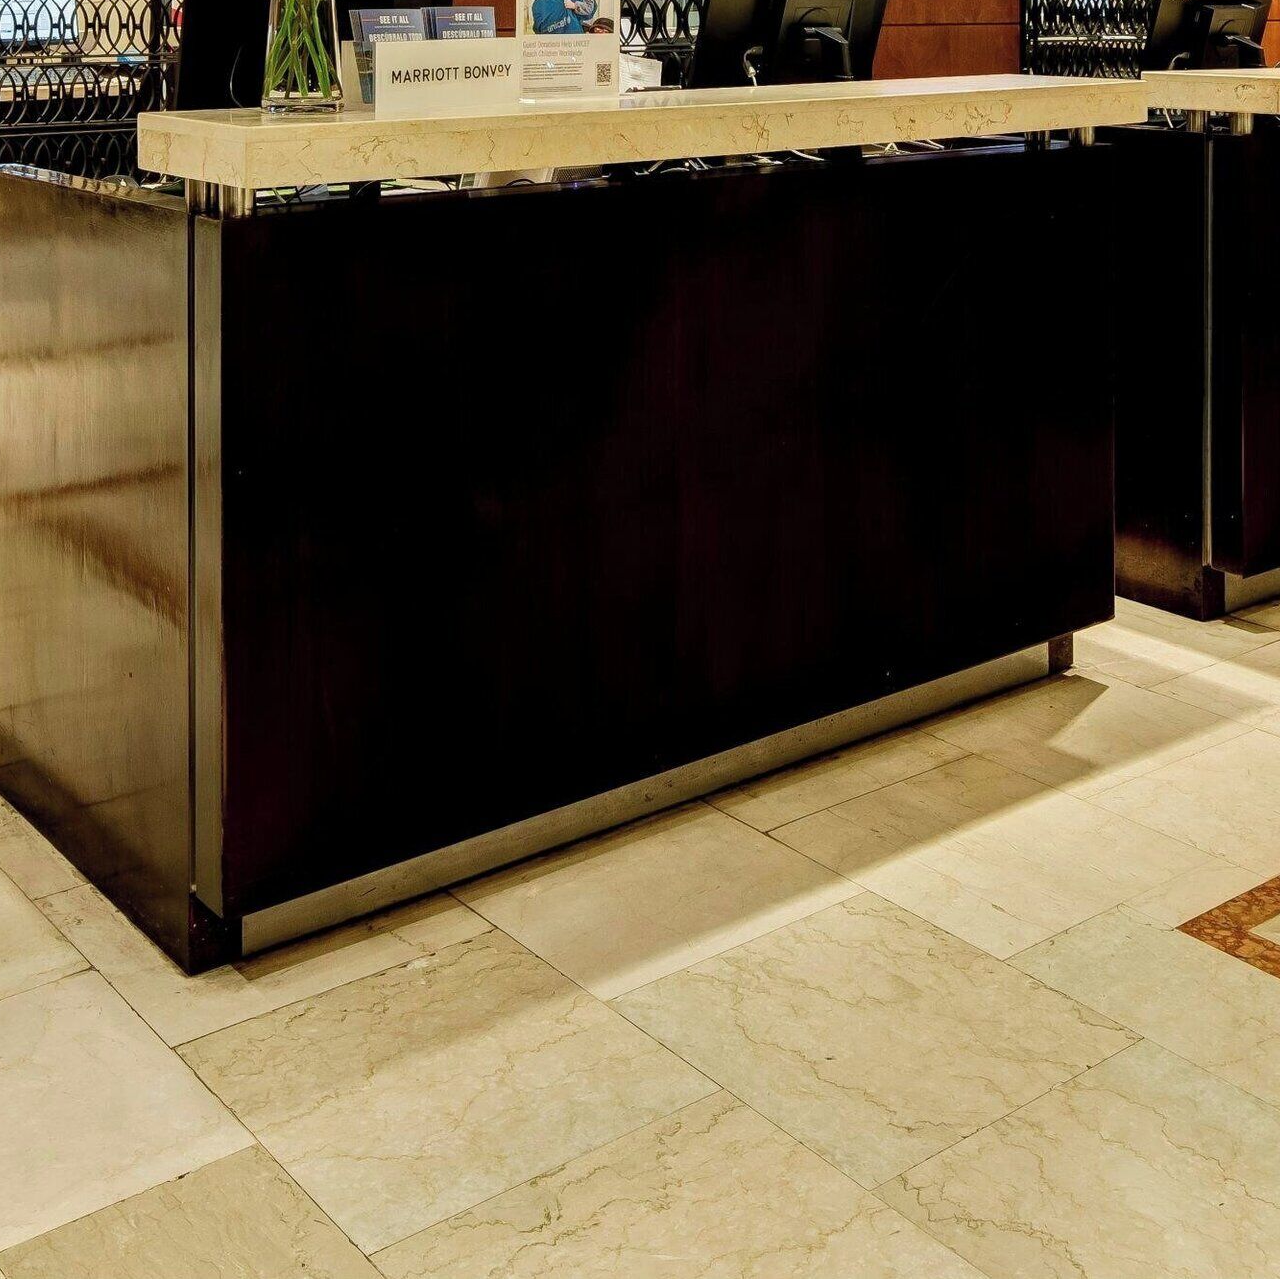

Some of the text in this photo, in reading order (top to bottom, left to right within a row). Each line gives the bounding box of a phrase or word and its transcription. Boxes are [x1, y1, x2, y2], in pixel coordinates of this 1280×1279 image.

[379, 15, 409, 24] SEE IT ALL
[454, 12, 483, 22] SEE IT ALL
[391, 66, 460, 84] MARRIOTT
[464, 63, 512, 79] BONVOY
